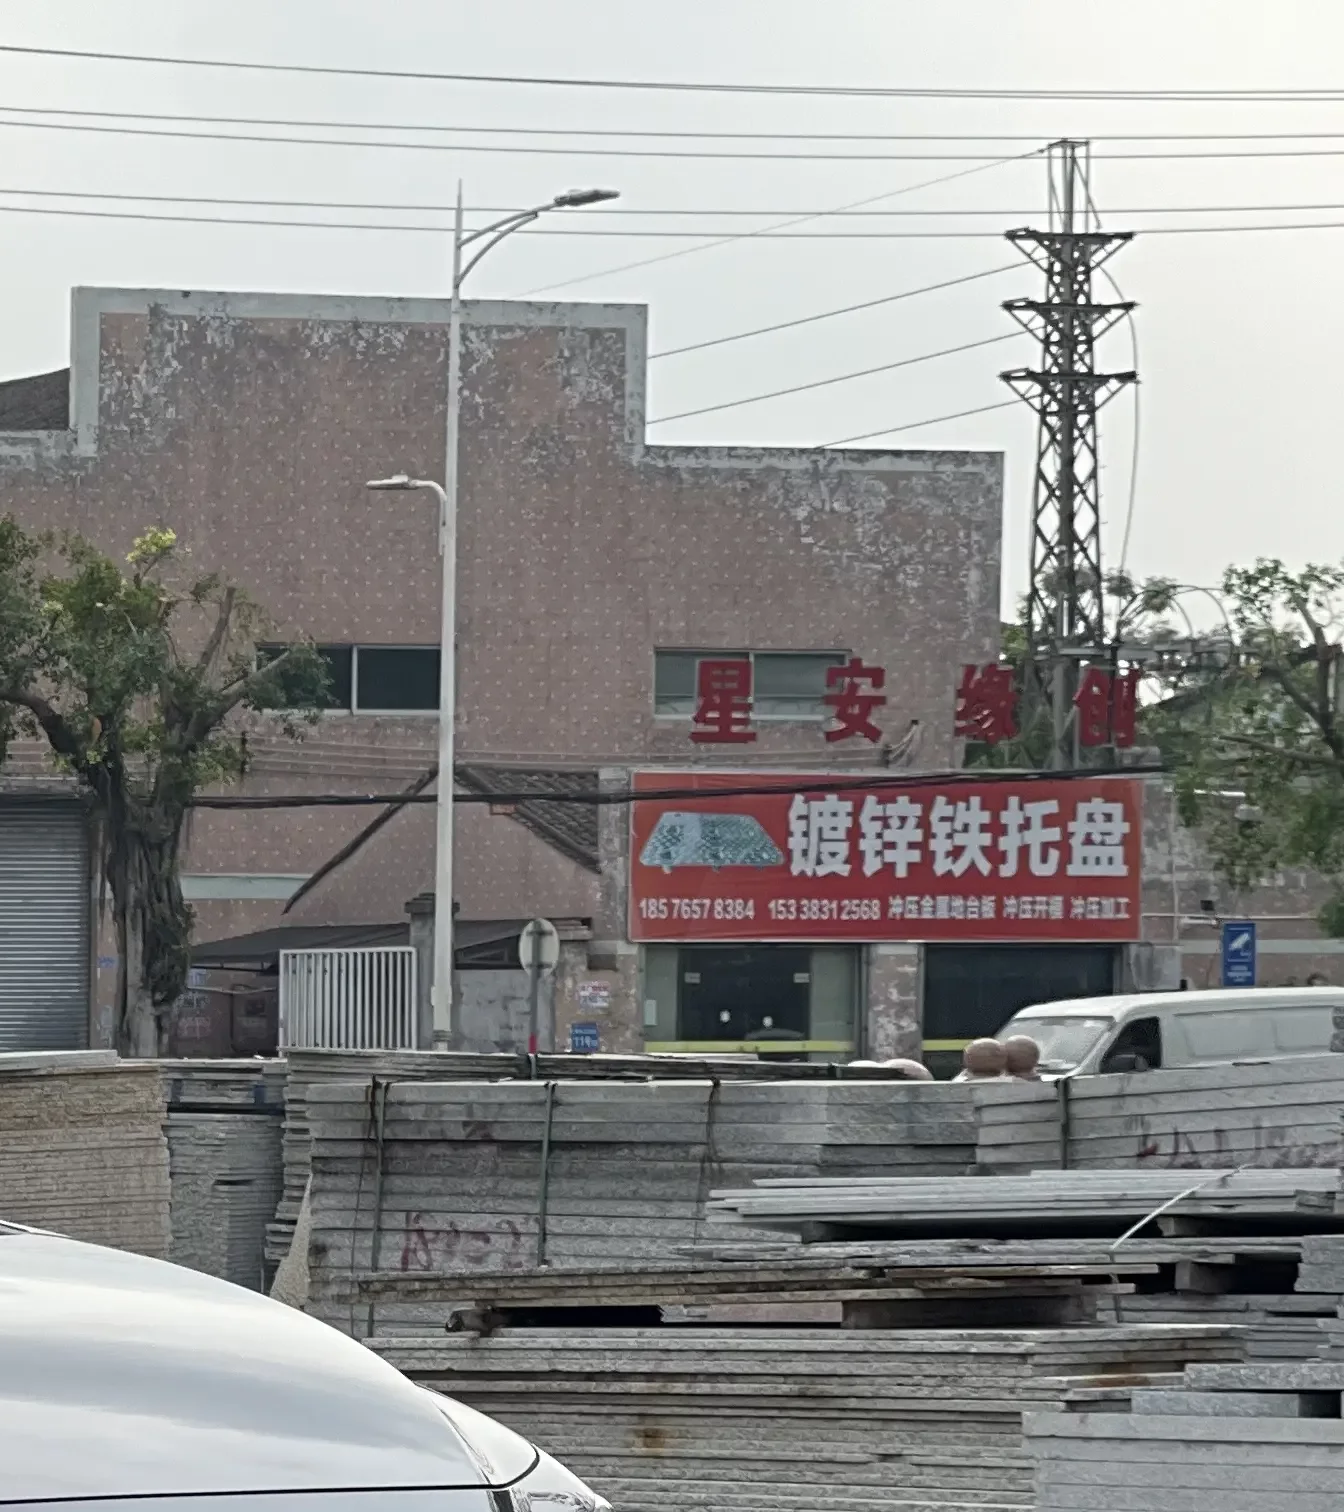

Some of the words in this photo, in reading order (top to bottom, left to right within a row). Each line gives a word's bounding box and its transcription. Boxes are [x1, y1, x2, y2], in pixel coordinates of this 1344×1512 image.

[787, 794, 1130, 878] 镀锌铁托盘
[639, 898, 668, 919] 185
[671, 898, 711, 919] 7657
[714, 898, 755, 920] 8384
[768, 899, 797, 920] 153
